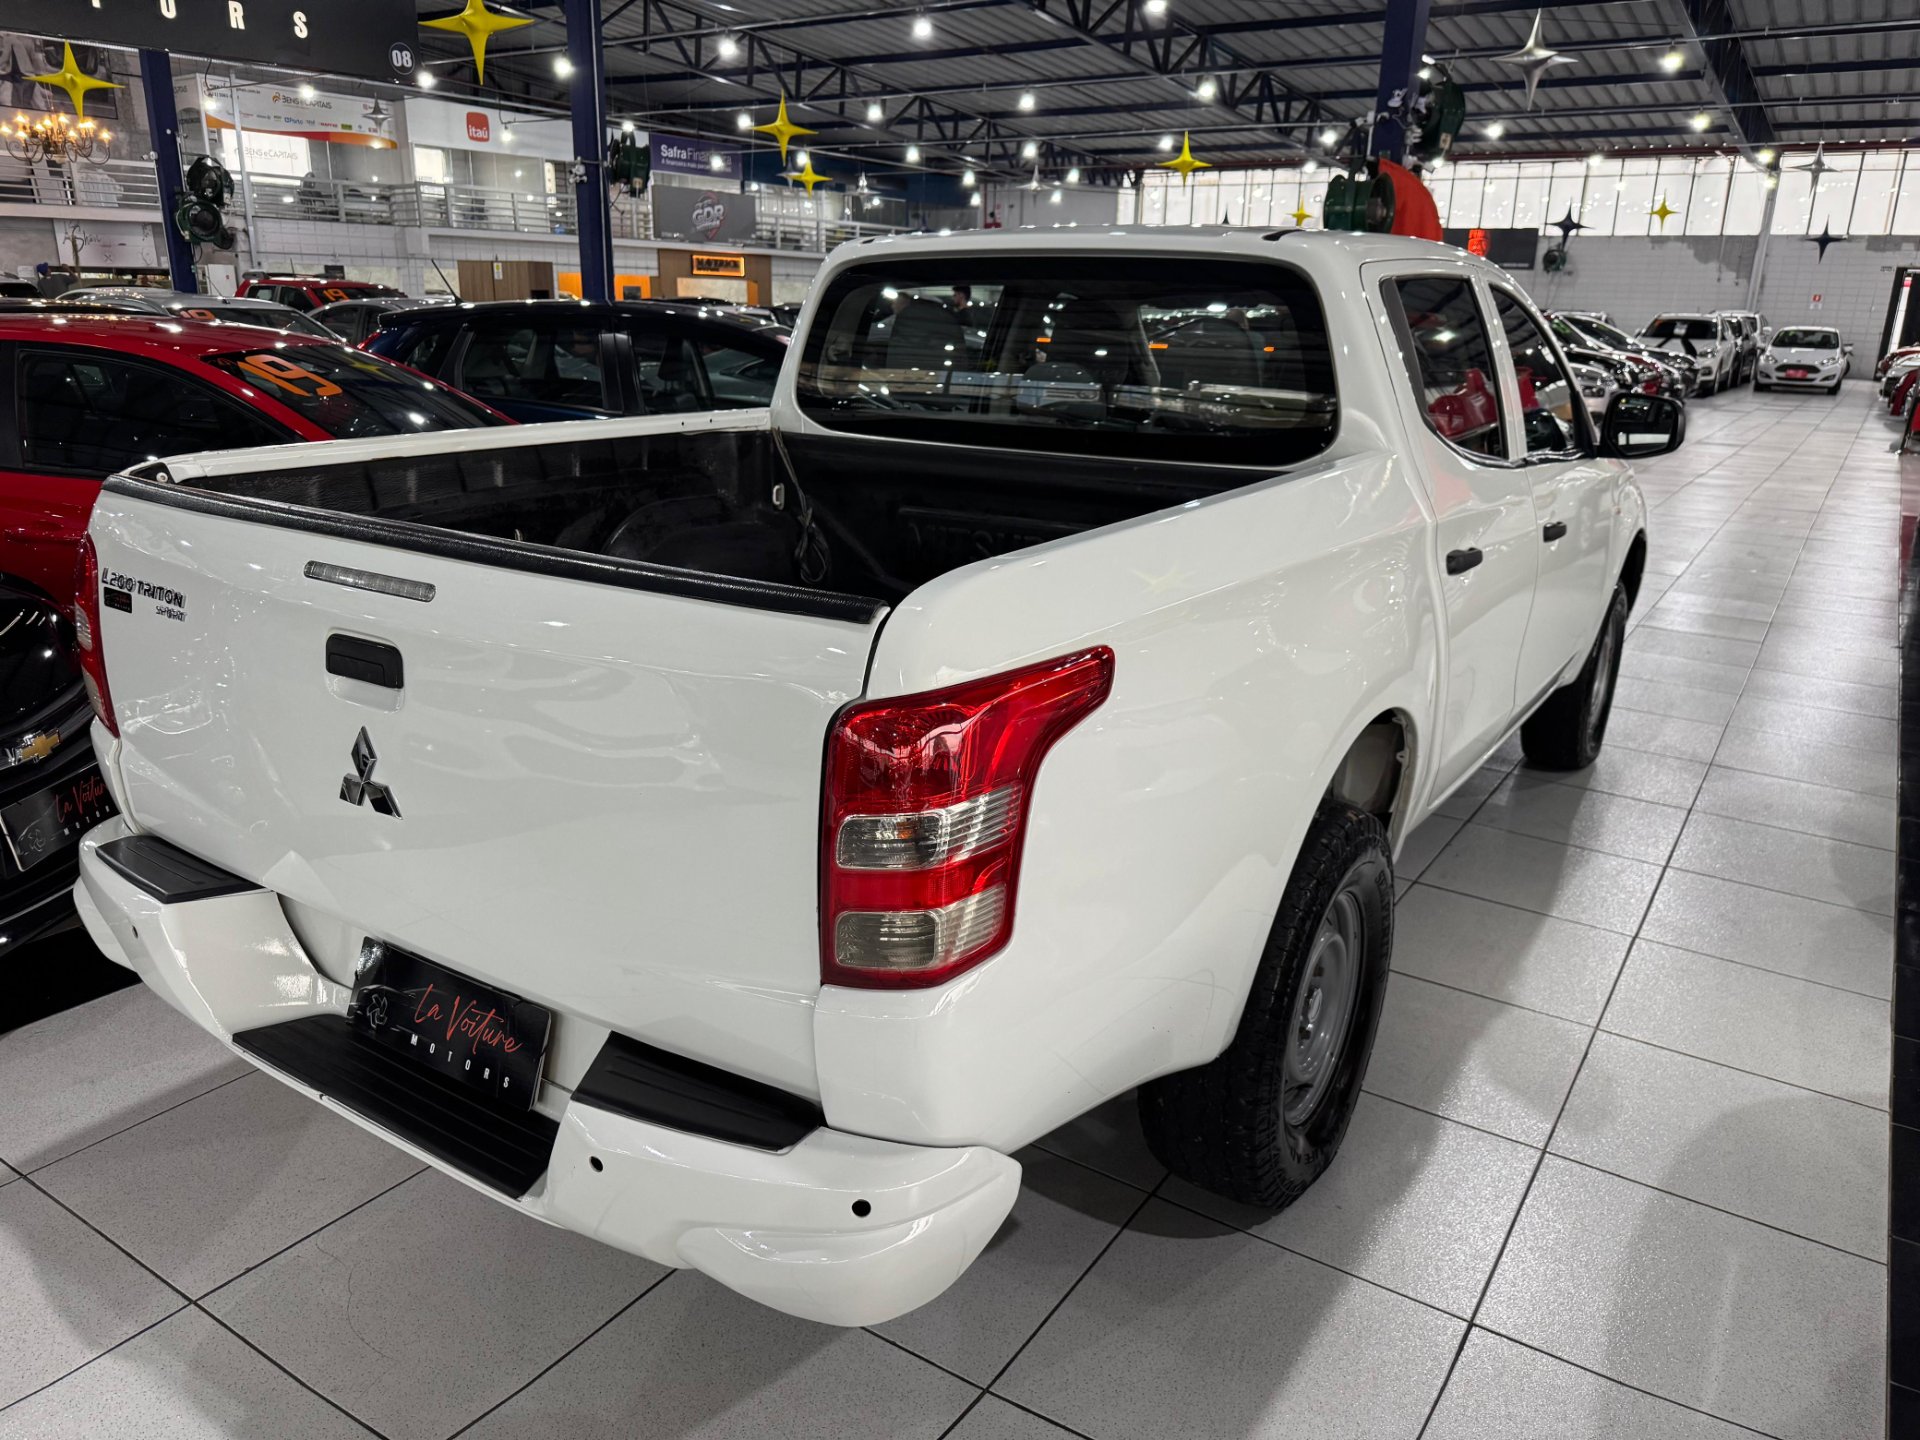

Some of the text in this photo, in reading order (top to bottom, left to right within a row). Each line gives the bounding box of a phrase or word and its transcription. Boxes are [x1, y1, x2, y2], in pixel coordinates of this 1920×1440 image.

[391, 49, 413, 68] 08
[468, 124, 489, 139] itaú
[237, 354, 343, 397] 19
[101, 567, 137, 592] L200
[137, 580, 186, 608] TRITON
[155, 605, 187, 622] SPORT
[413, 983, 523, 1055] La Voiture
[410, 1033, 510, 1088] MOTORS
